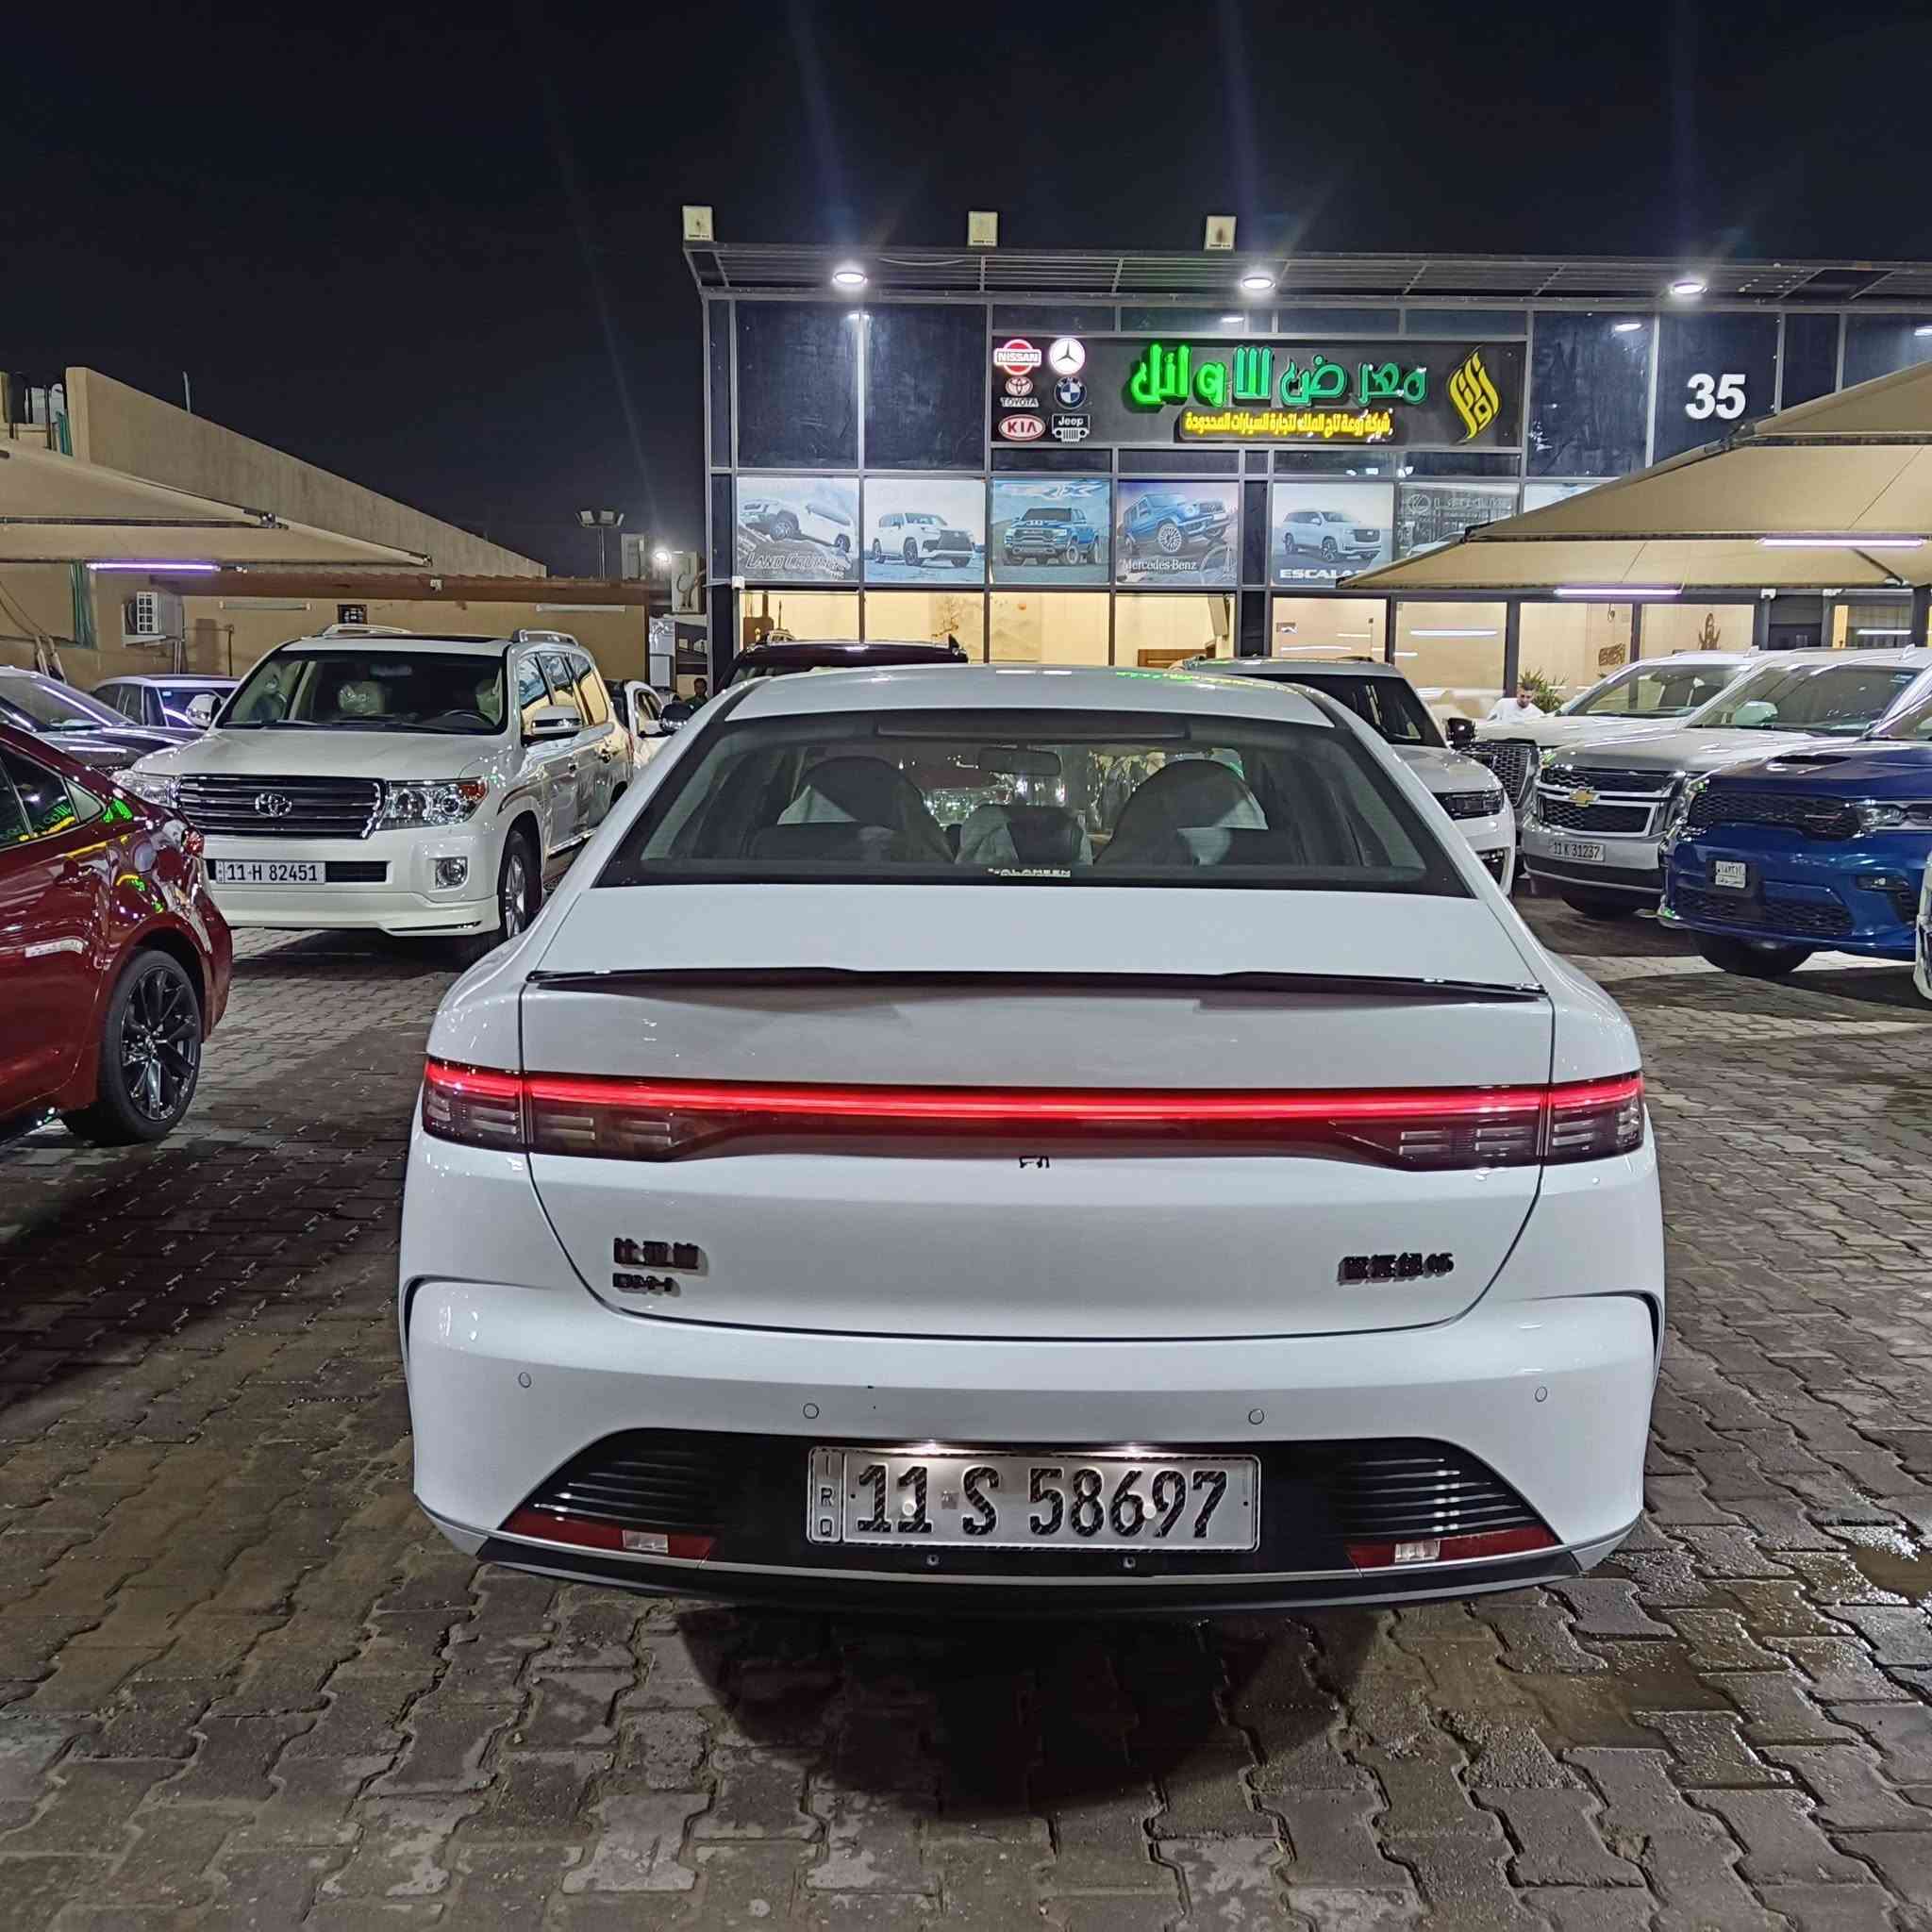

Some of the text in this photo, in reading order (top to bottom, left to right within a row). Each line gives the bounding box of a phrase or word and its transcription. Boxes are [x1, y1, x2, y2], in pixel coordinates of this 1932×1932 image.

[996, 351, 1039, 363] NISSAN
[1280, 355, 1427, 408] معرض
[1000, 397, 1040, 408] TOYOTA
[1685, 373, 1747, 420] 35
[1007, 421, 1039, 433] KIA
[1058, 416, 1085, 427] Jeep
[1121, 558, 1197, 571] Mercedes-Benz
[226, 863, 246, 881] 11
[252, 863, 263, 881] H
[269, 864, 318, 882] 82451
[857, 1463, 1228, 1540] 11 S 58697
